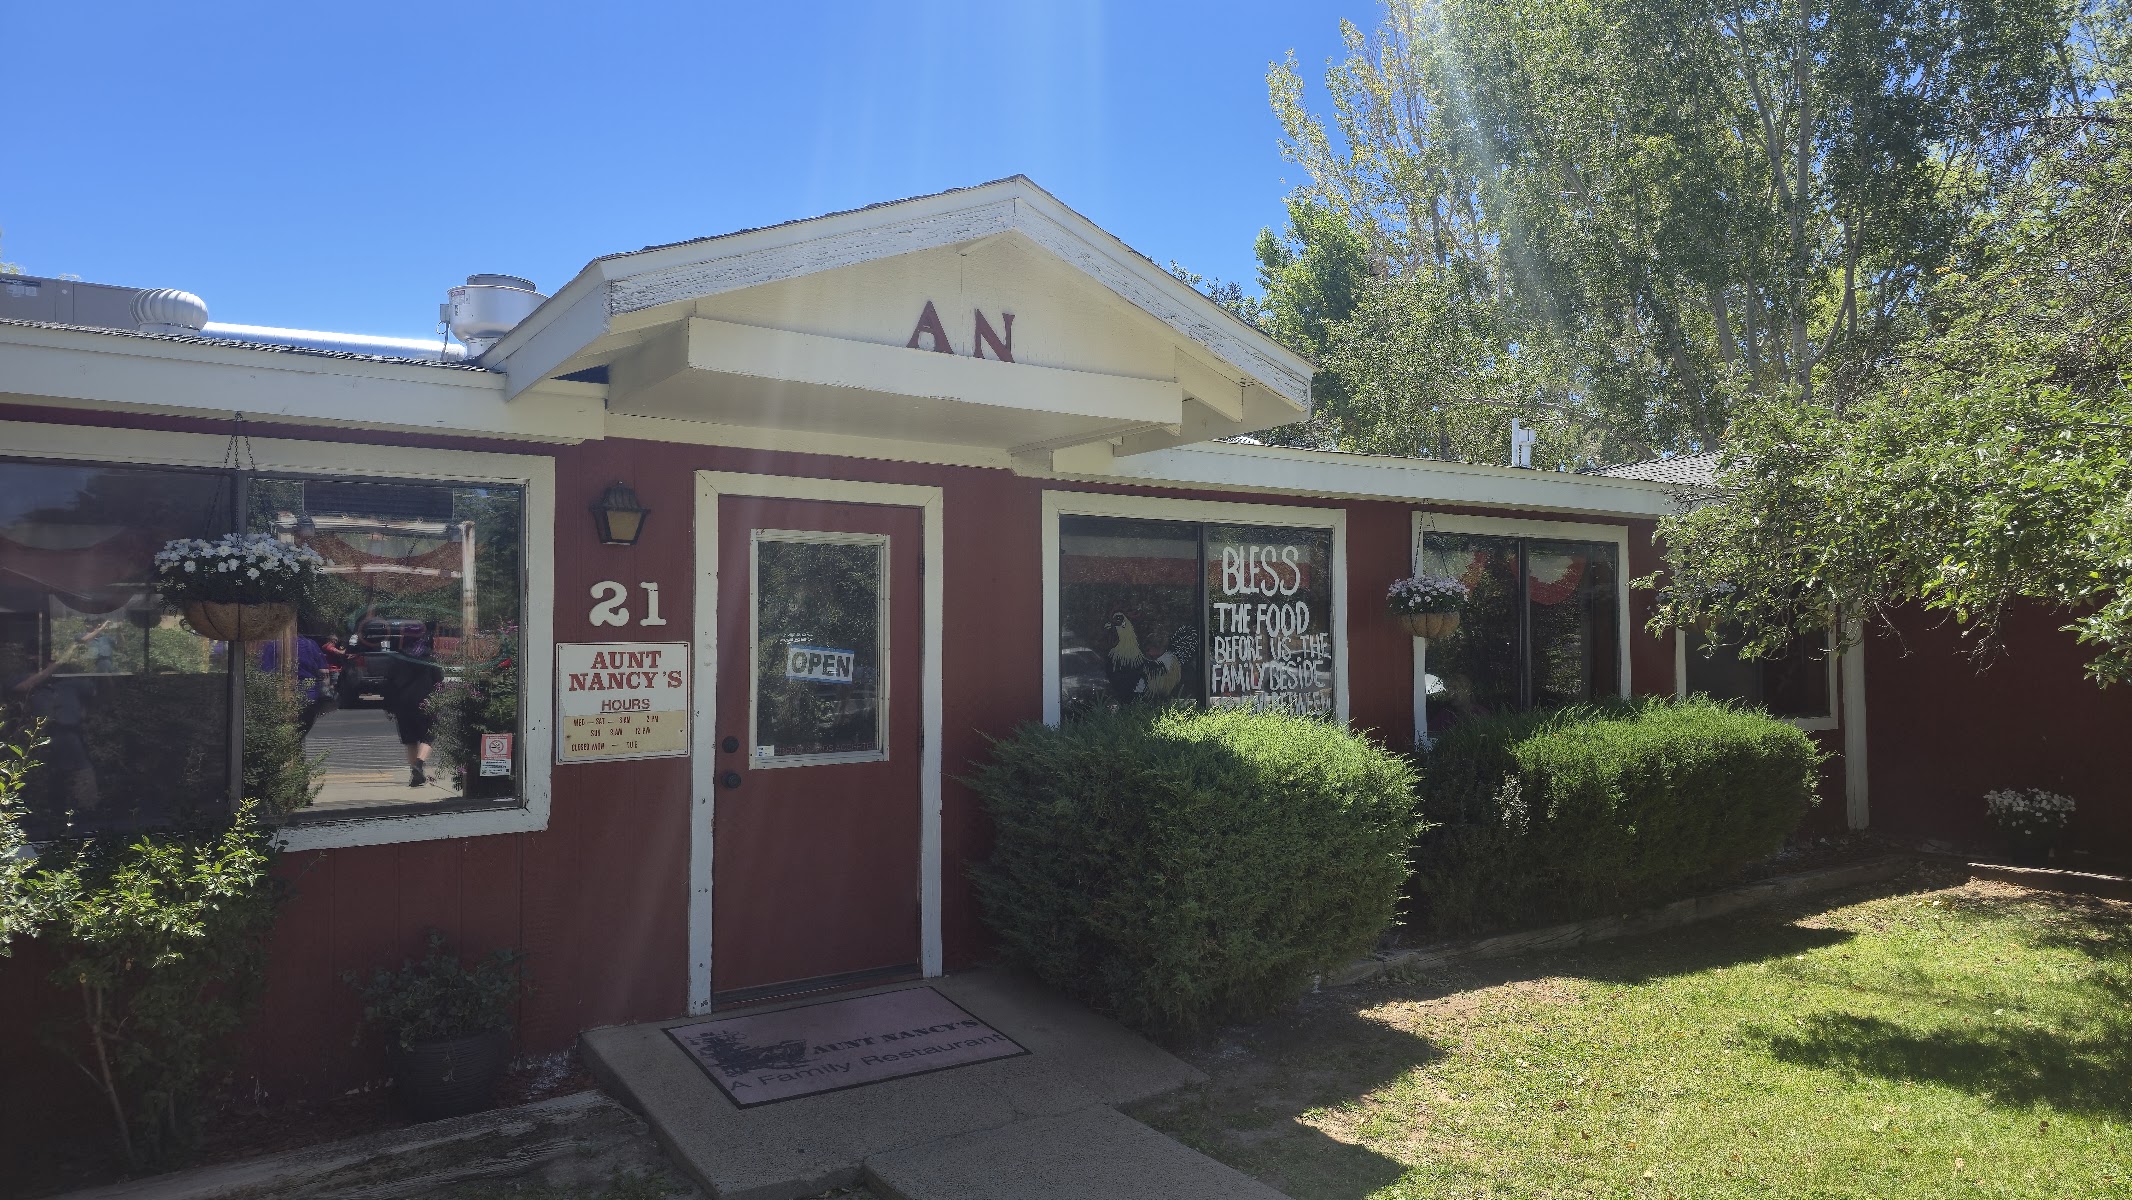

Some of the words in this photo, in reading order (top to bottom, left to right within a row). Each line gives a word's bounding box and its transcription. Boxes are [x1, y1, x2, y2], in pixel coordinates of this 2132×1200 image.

[1222, 545, 1301, 597] BLESS
[589, 580, 667, 627] 21
[1213, 602, 1252, 634] THE
[1256, 600, 1310, 638] FOOD
[590, 650, 662, 670] AUNT
[791, 651, 851, 678] OPEN
[1214, 635, 1263, 664] BEFORE
[1270, 636, 1292, 661] US
[1300, 632, 1330, 660] THE
[568, 671, 683, 692] NANCY'S
[601, 698, 651, 712] HOURS
[813, 1037, 875, 1055] AUNT
[880, 1020, 979, 1042] NANCY'S
[731, 1080, 752, 1091] A
[757, 1062, 850, 1086] Family
[860, 1033, 1007, 1066] Restaurant
